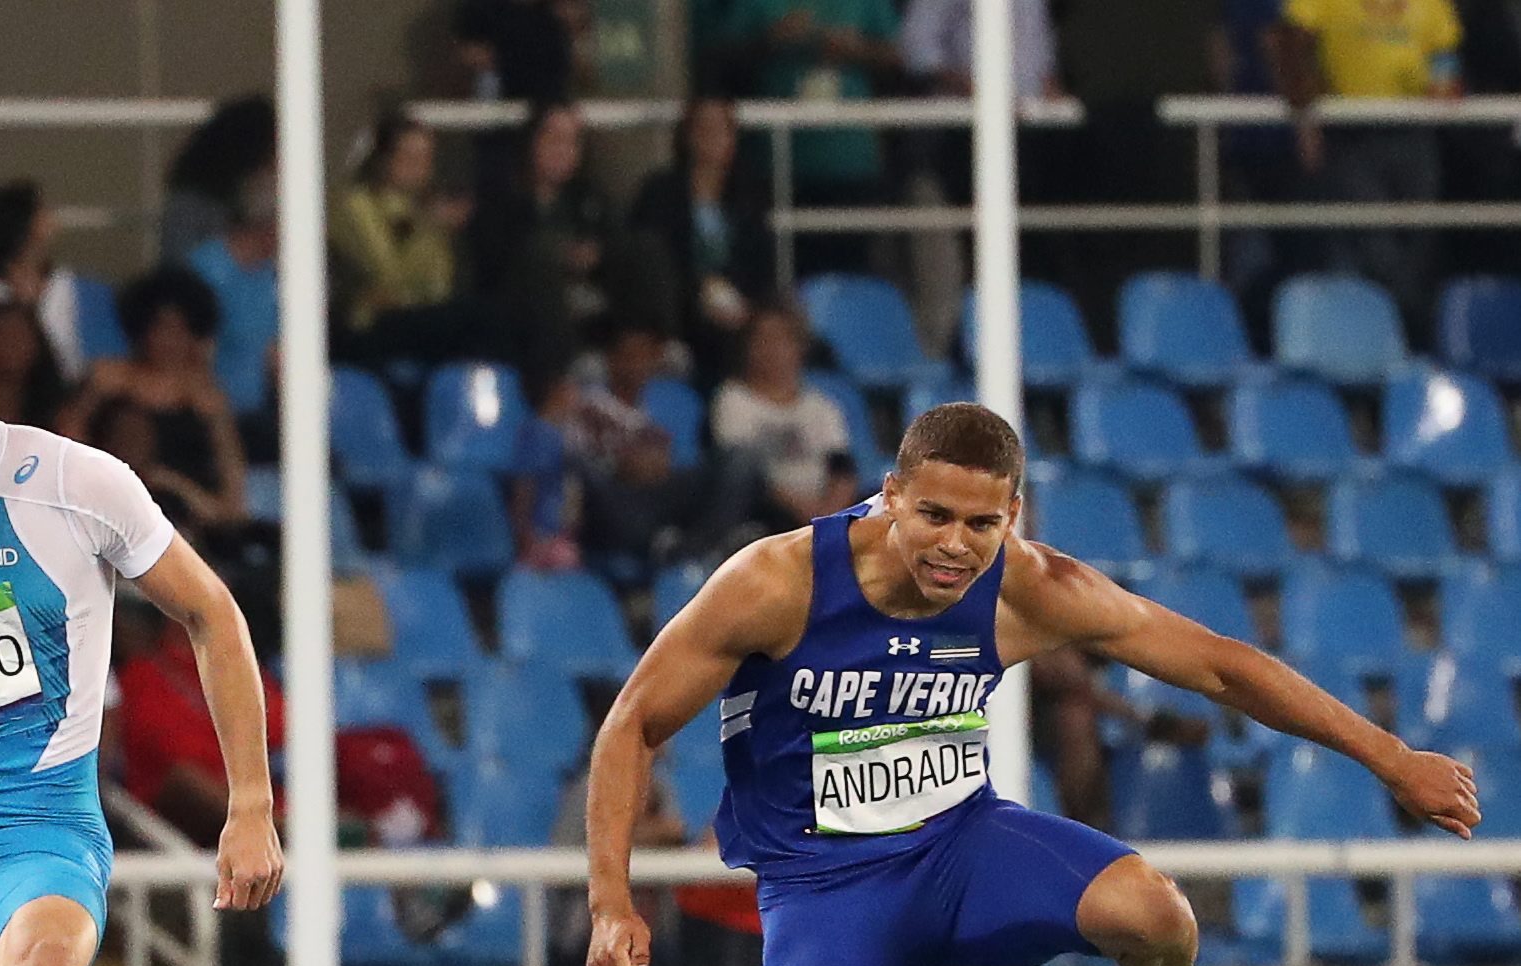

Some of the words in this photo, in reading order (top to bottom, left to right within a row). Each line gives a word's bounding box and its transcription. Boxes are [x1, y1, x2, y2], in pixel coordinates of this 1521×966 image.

[789, 668, 882, 718] CAPE
[838, 724, 909, 746] Rio2016
[819, 741, 981, 808] ANDRADE
